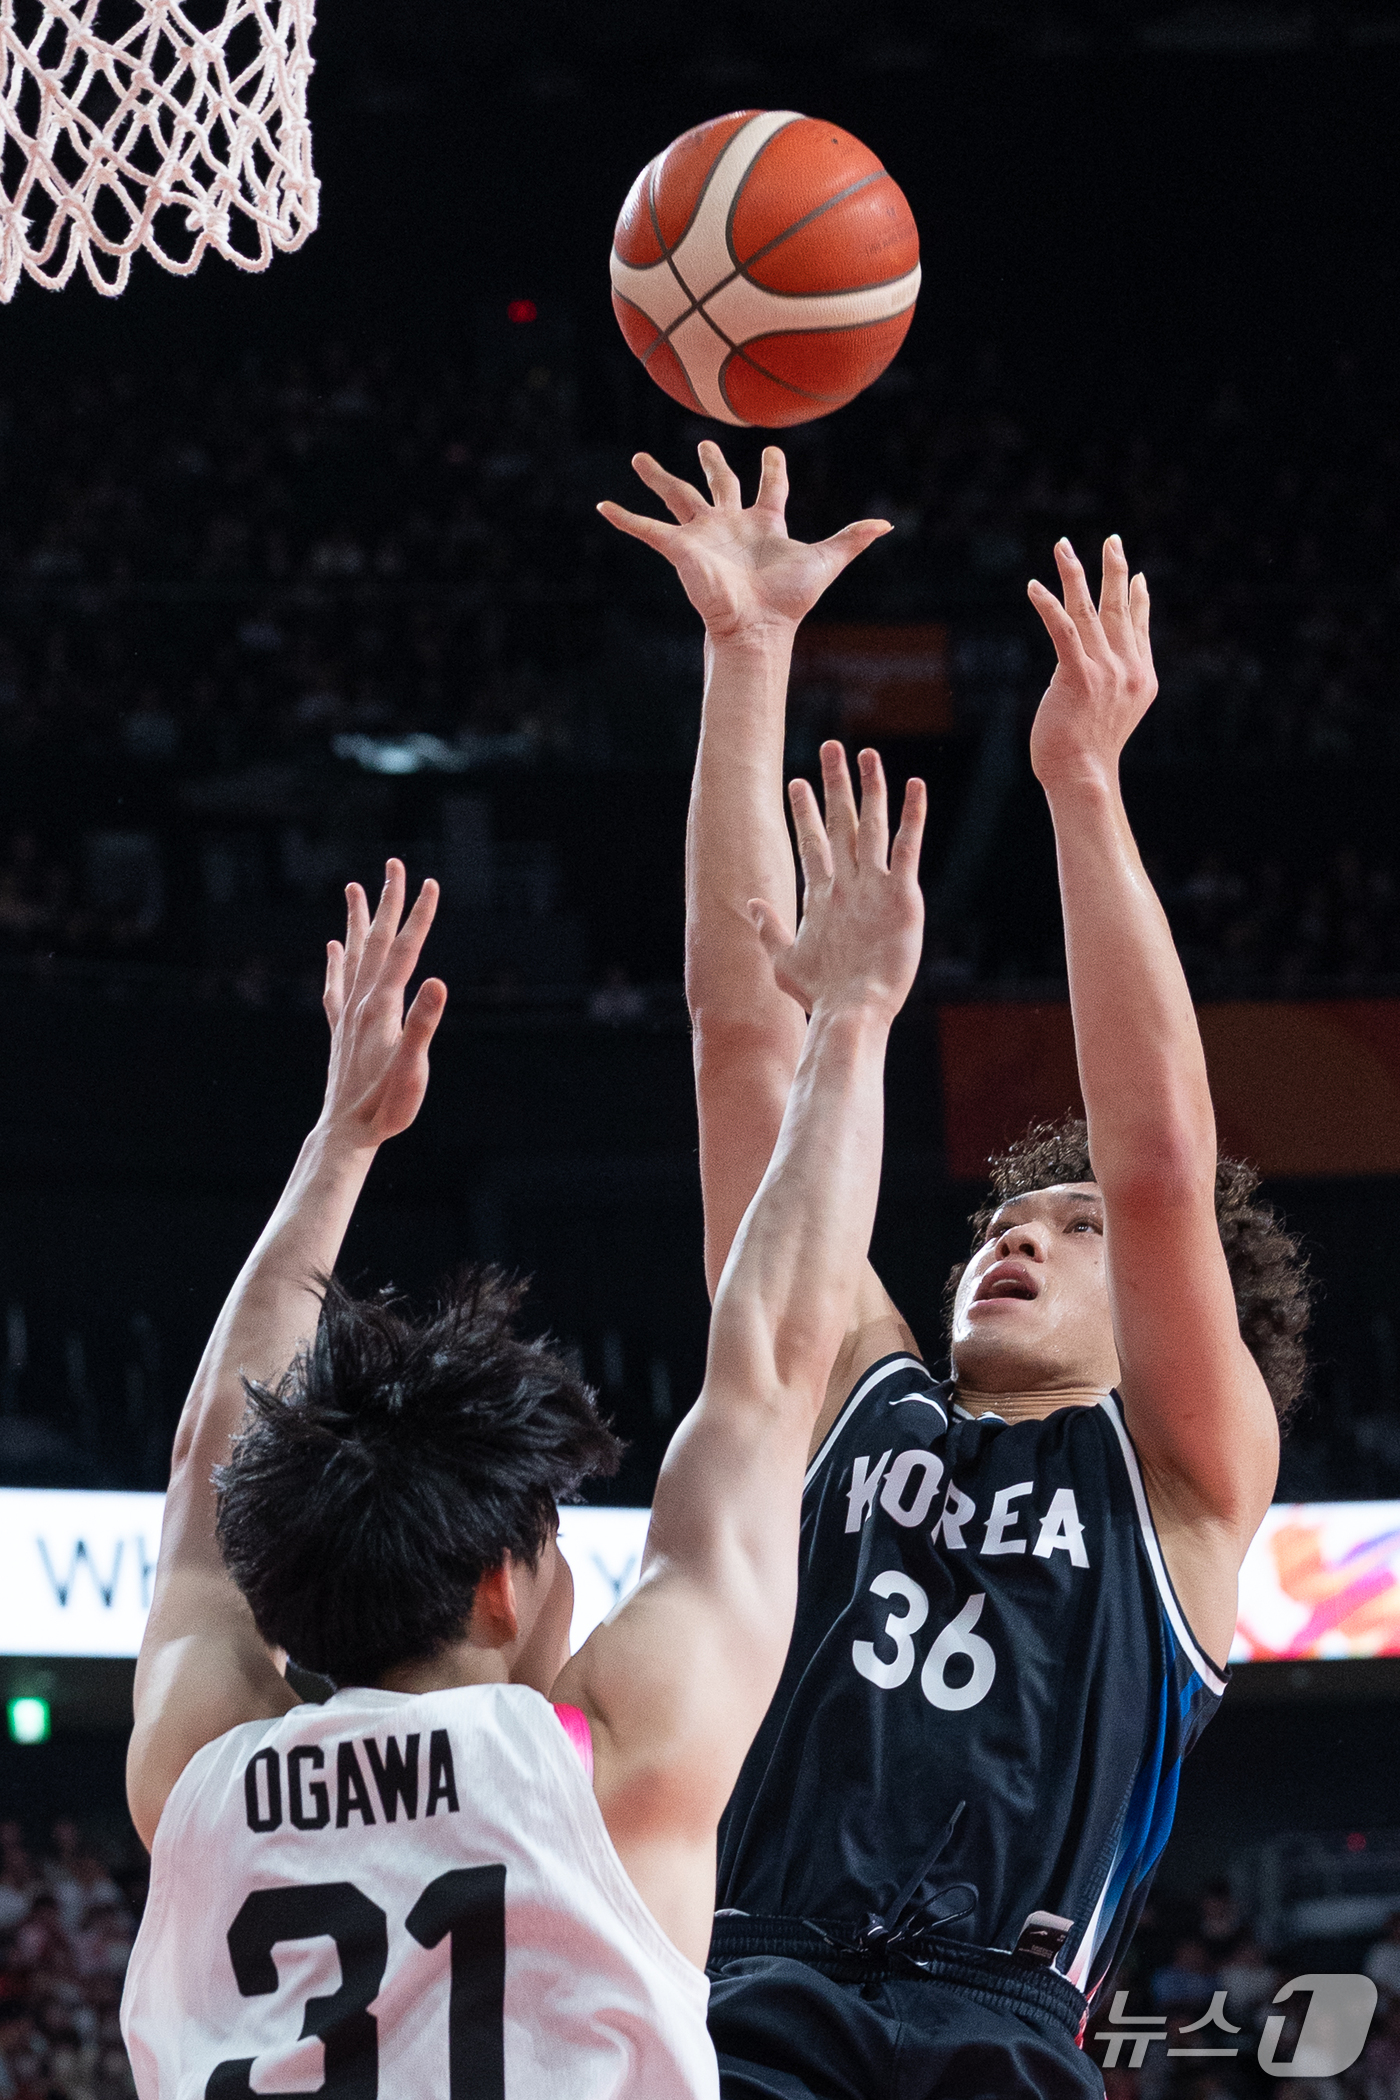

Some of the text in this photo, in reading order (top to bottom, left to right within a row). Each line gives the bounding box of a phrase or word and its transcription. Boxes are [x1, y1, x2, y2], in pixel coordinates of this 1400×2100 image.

[844, 1448, 1091, 1569] KOREA
[851, 1569, 997, 1712] 36
[244, 1728, 461, 1834] OGAWA
[204, 1863, 508, 2100] 31
